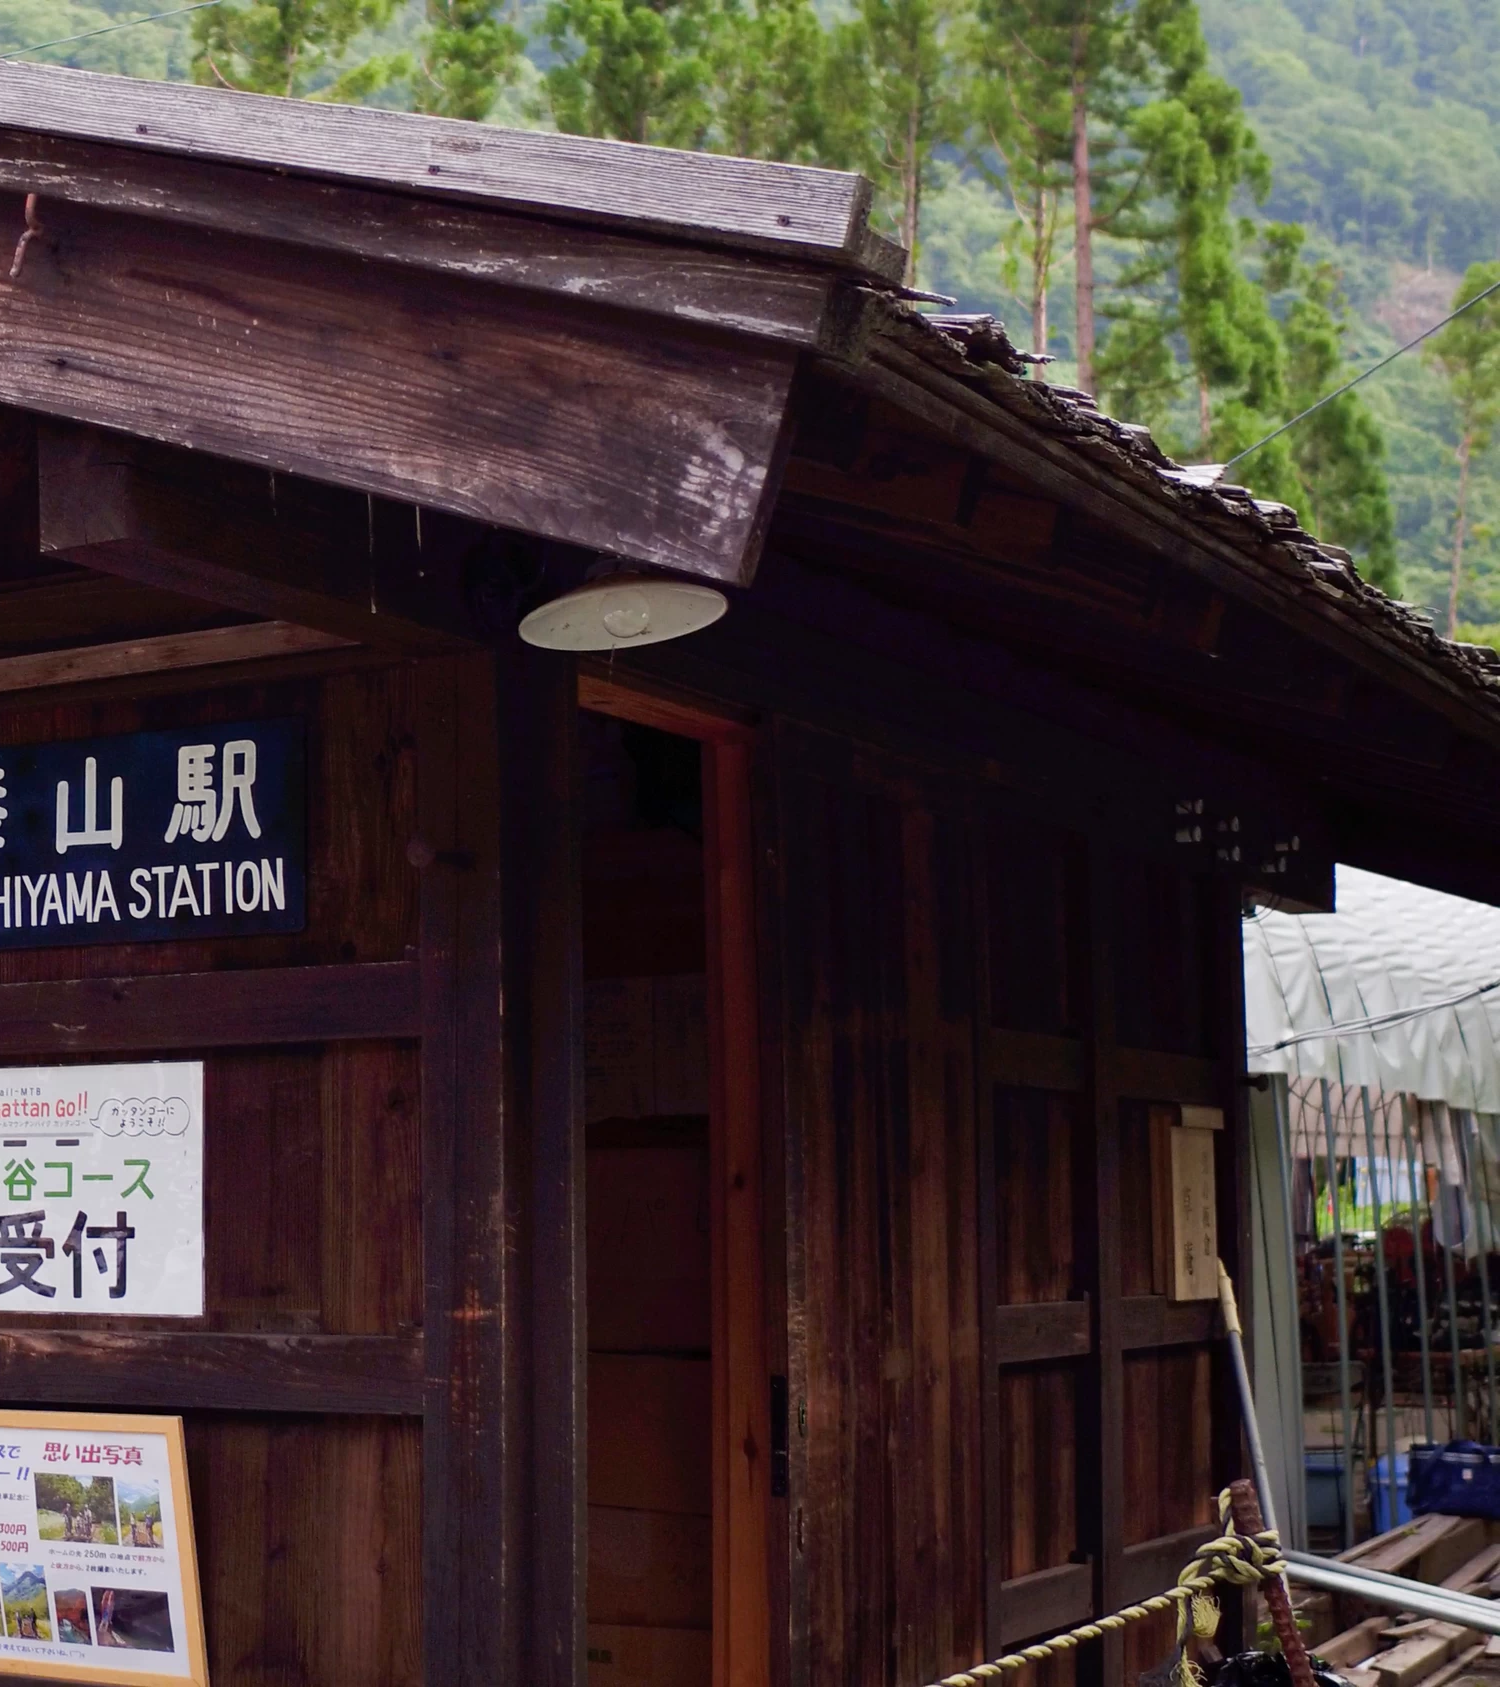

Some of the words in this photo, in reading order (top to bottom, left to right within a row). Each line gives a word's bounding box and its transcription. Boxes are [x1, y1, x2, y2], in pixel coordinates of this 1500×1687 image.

[128, 857, 286, 919] STATION
[55, 1090, 88, 1118] Go!!
[111, 1105, 175, 1116] ガッタンゴーに
[42, 1441, 144, 1467] 思い出写真
[0, 1523, 27, 1536] 300円
[0, 1540, 29, 1553] 500円
